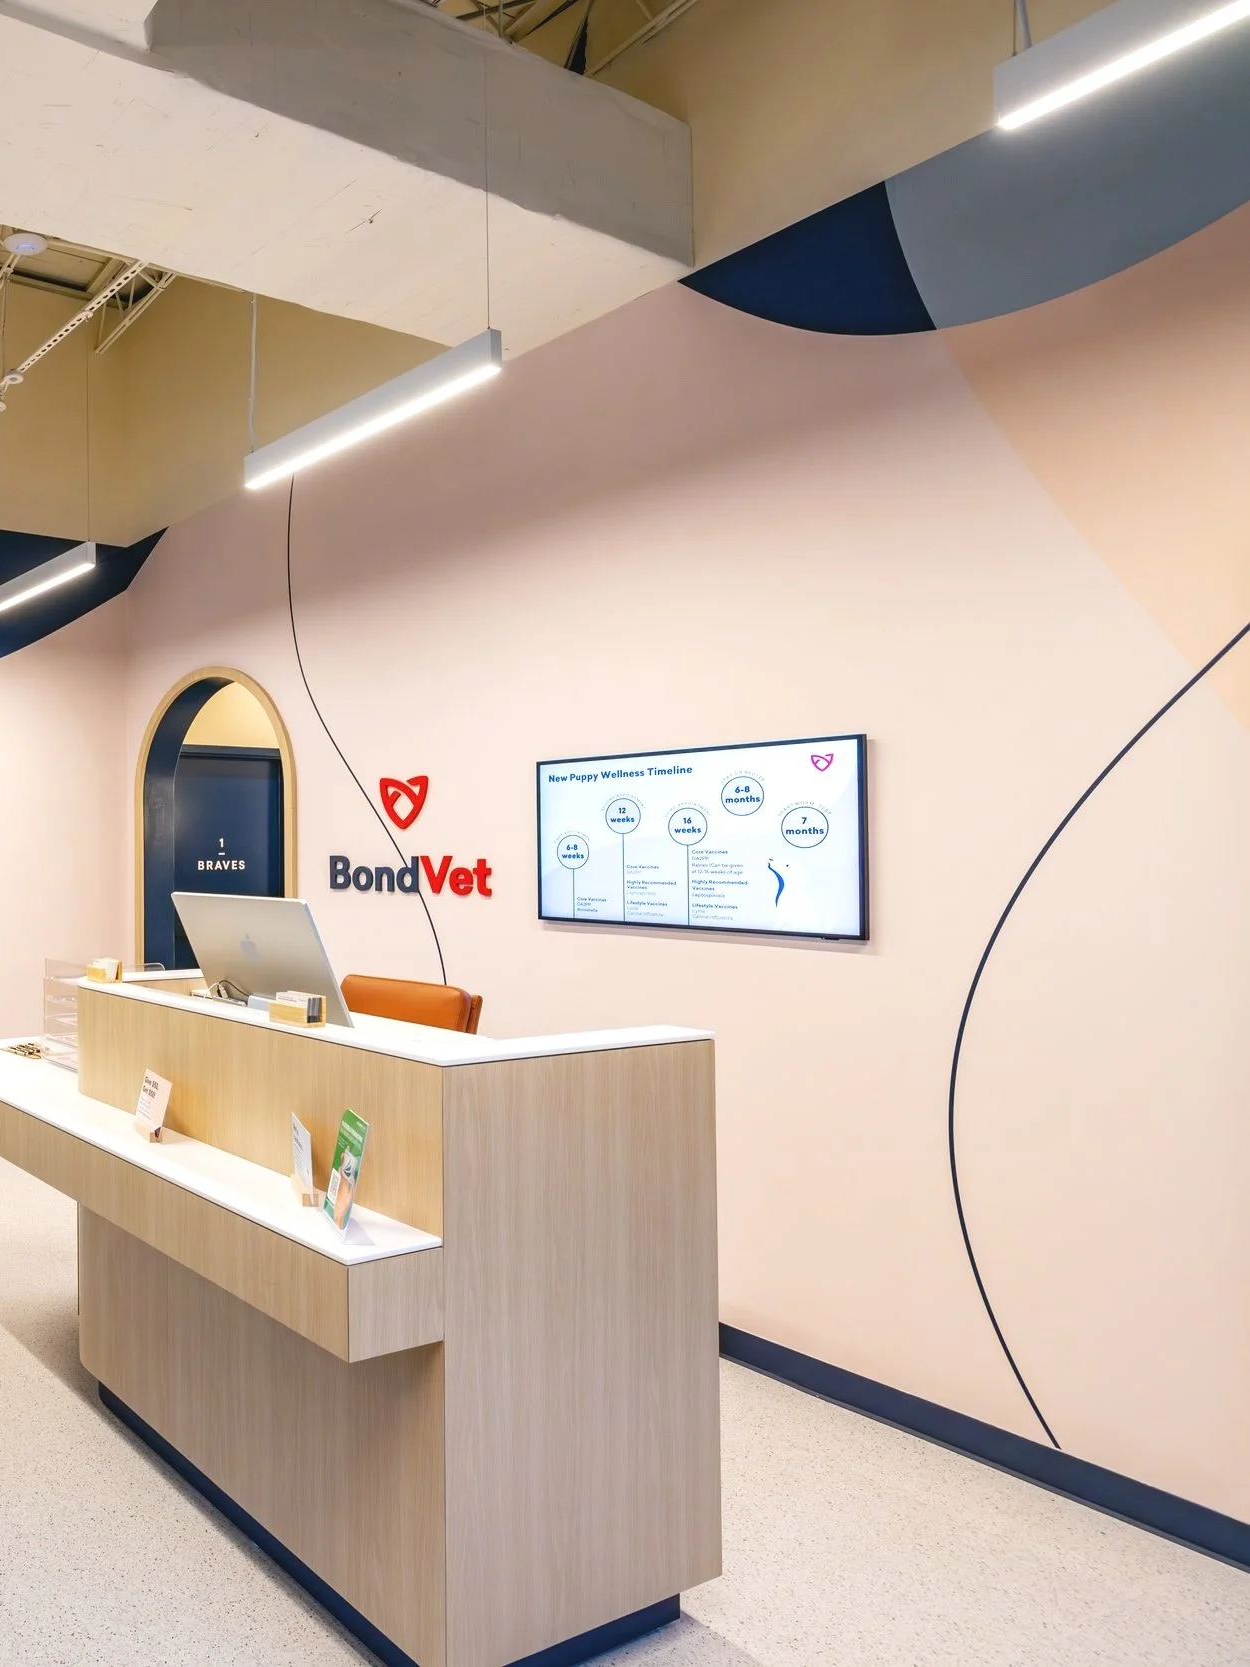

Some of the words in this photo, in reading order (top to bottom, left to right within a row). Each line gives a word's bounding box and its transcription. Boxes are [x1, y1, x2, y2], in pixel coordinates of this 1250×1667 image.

[548, 774, 568, 783] New
[569, 773, 599, 783] Puppy
[600, 769, 645, 779] Wellness
[647, 765, 693, 776] Timeline
[734, 785, 750, 794] 6-8
[725, 795, 761, 803] months
[801, 816, 808, 825] 7
[785, 827, 825, 835] months
[218, 837, 224, 848] 1
[197, 860, 246, 870] BRAVES
[329, 855, 492, 896] BondVet
